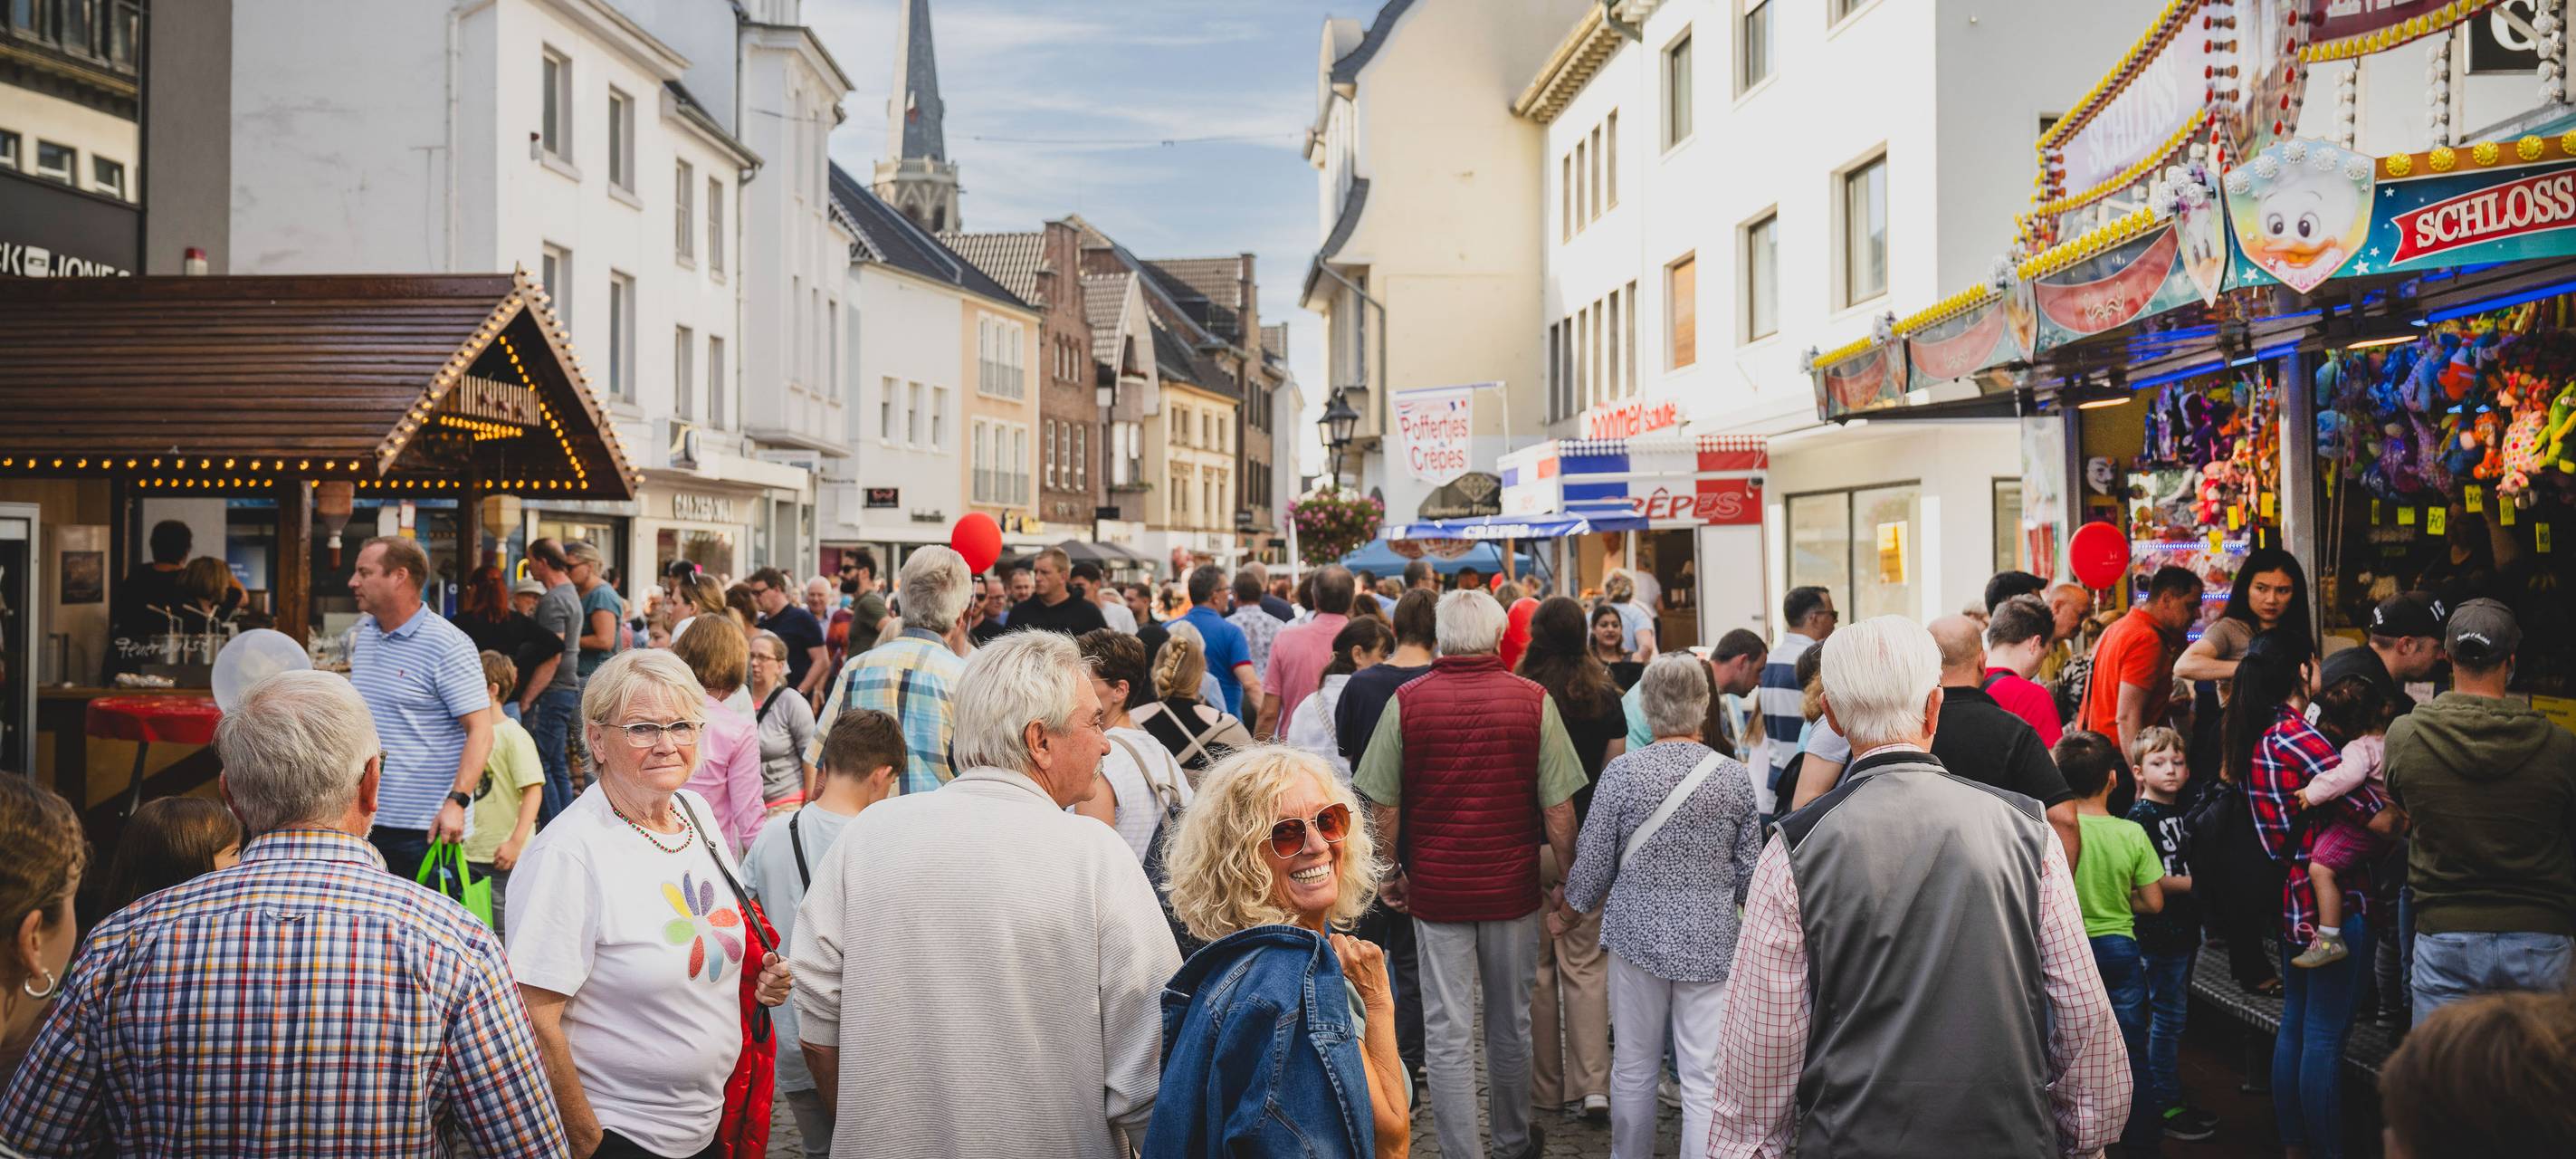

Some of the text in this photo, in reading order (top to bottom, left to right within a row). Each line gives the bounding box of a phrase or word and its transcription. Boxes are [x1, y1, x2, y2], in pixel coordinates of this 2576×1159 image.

[2415, 175, 2576, 249] SCHLOSS
[1400, 414, 1467, 445] Poffertjes
[1412, 445, 1464, 476] Crêpes
[1599, 486, 1741, 521] RÊPES
